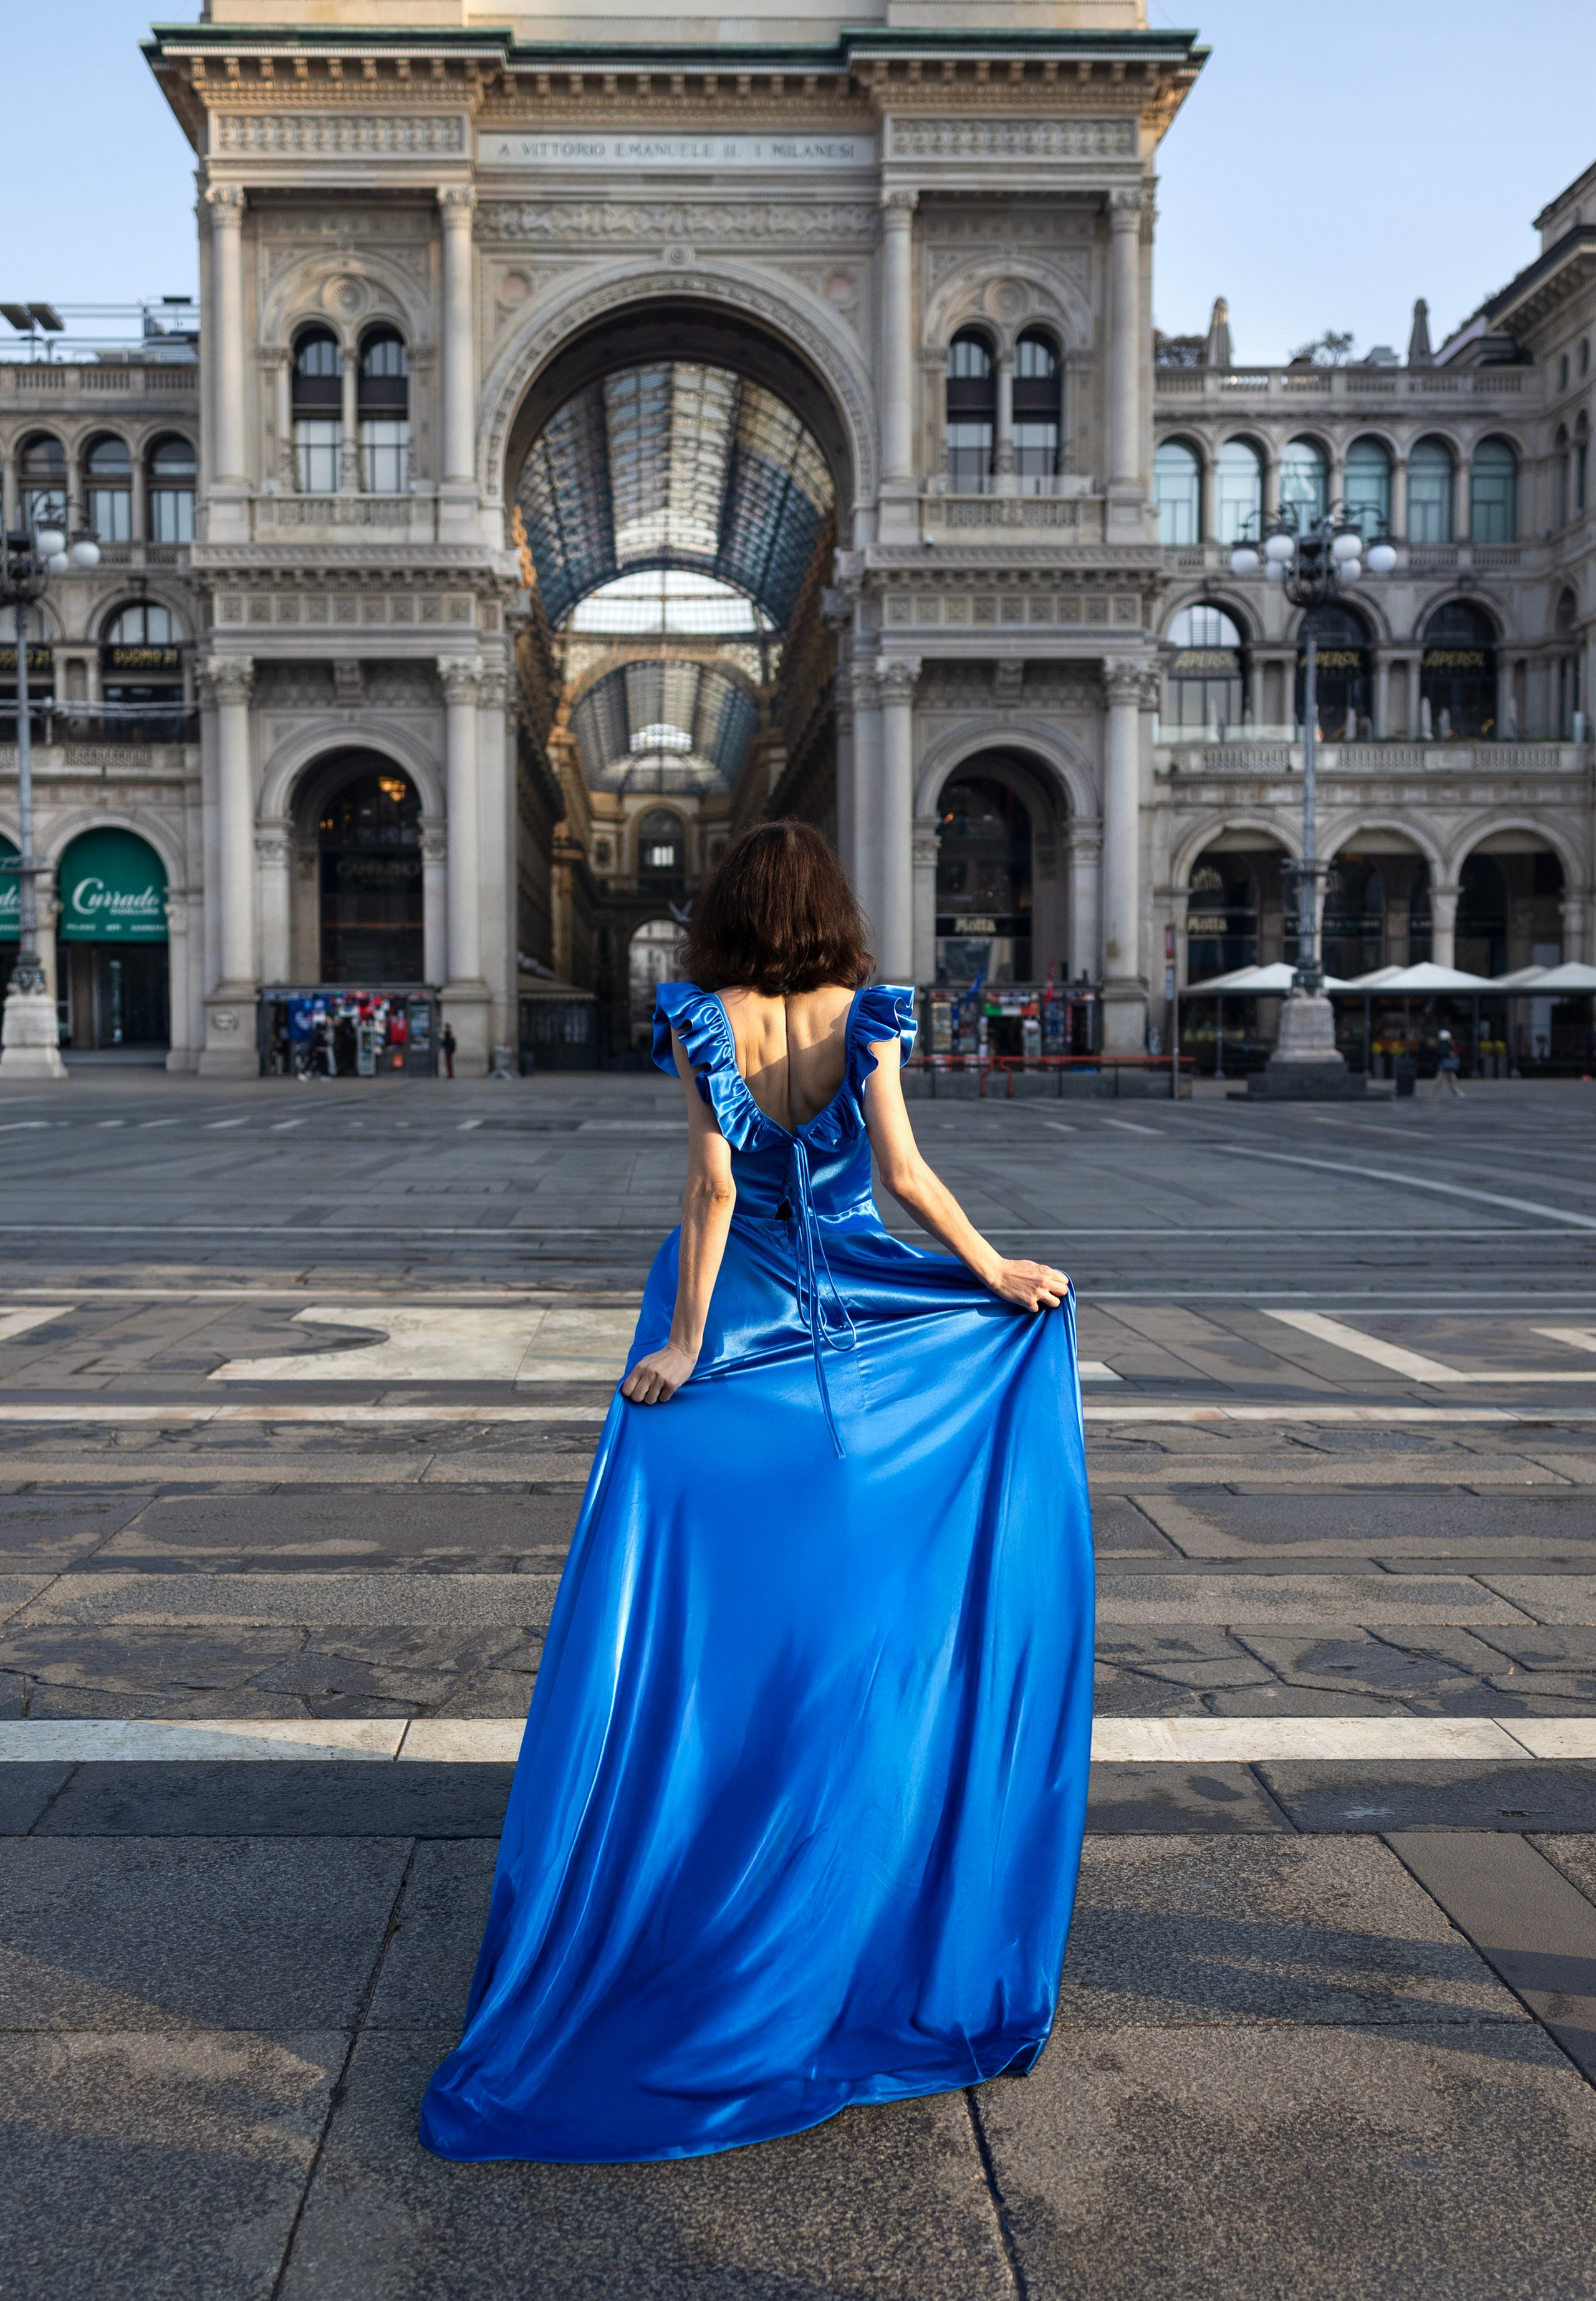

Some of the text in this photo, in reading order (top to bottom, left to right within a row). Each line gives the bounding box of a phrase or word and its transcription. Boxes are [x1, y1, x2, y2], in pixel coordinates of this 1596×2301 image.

[498, 143, 511, 156] A
[521, 143, 606, 156] VITTORIO
[614, 143, 714, 156] EMANUELE
[755, 143, 761, 156] I
[771, 143, 853, 156] MILANESI
[113, 649, 162, 663] DUOMO
[1174, 651, 1235, 668] APEROL
[1425, 650, 1484, 668] APEROL
